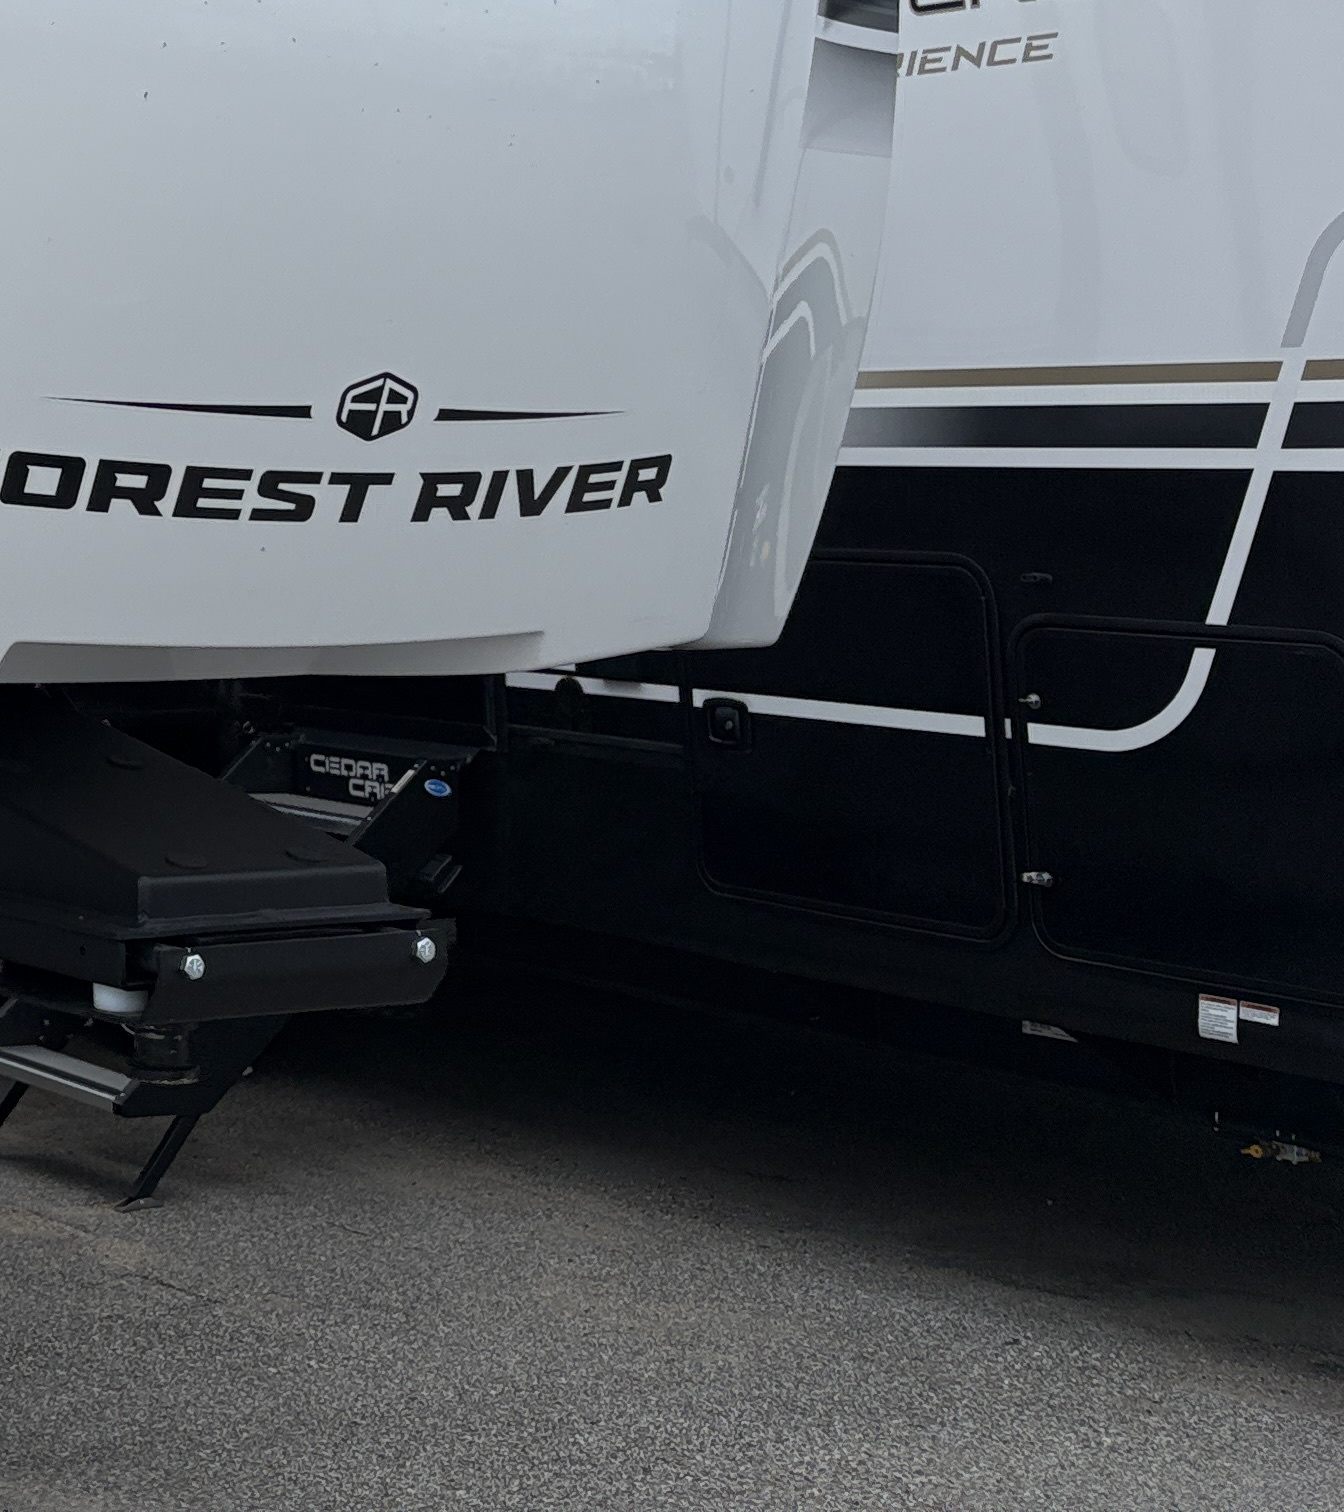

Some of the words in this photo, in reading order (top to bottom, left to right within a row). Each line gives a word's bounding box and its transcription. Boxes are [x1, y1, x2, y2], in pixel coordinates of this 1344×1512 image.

[896, 32, 1059, 78] IENCE
[410, 454, 673, 524] RIVER
[310, 753, 390, 782] CEDAR
